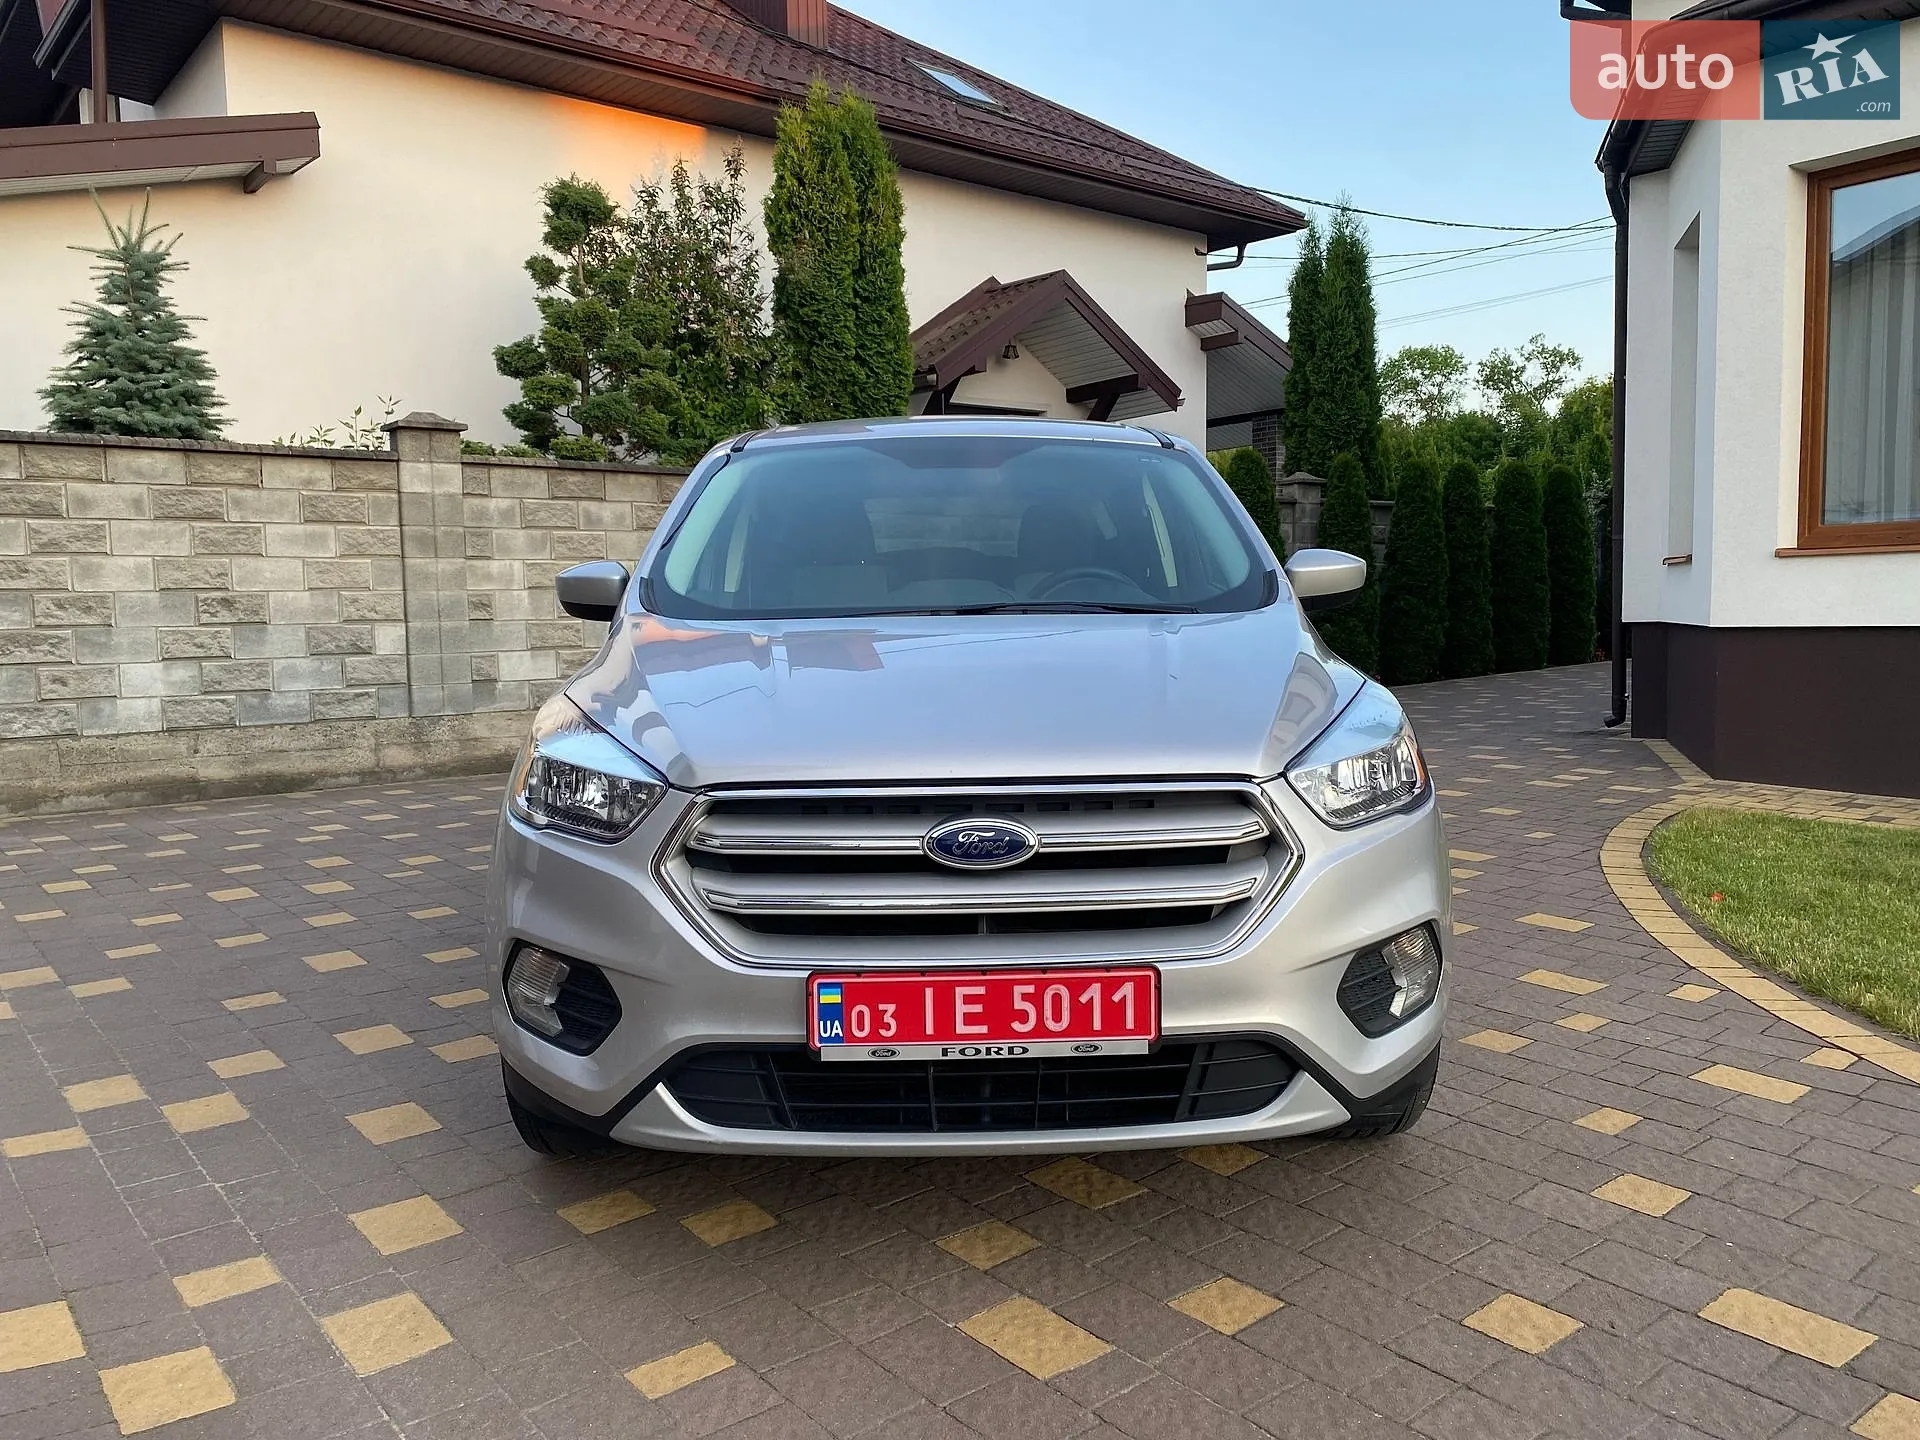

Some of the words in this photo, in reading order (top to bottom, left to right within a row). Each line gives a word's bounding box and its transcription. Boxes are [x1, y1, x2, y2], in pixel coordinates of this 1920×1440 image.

[952, 831, 1010, 855] Ford
[851, 1004, 897, 1038] 03
[924, 986, 989, 1036] IE
[1010, 981, 1135, 1034] 5011
[819, 1020, 844, 1038] UA
[941, 1045, 1029, 1058] FORD
